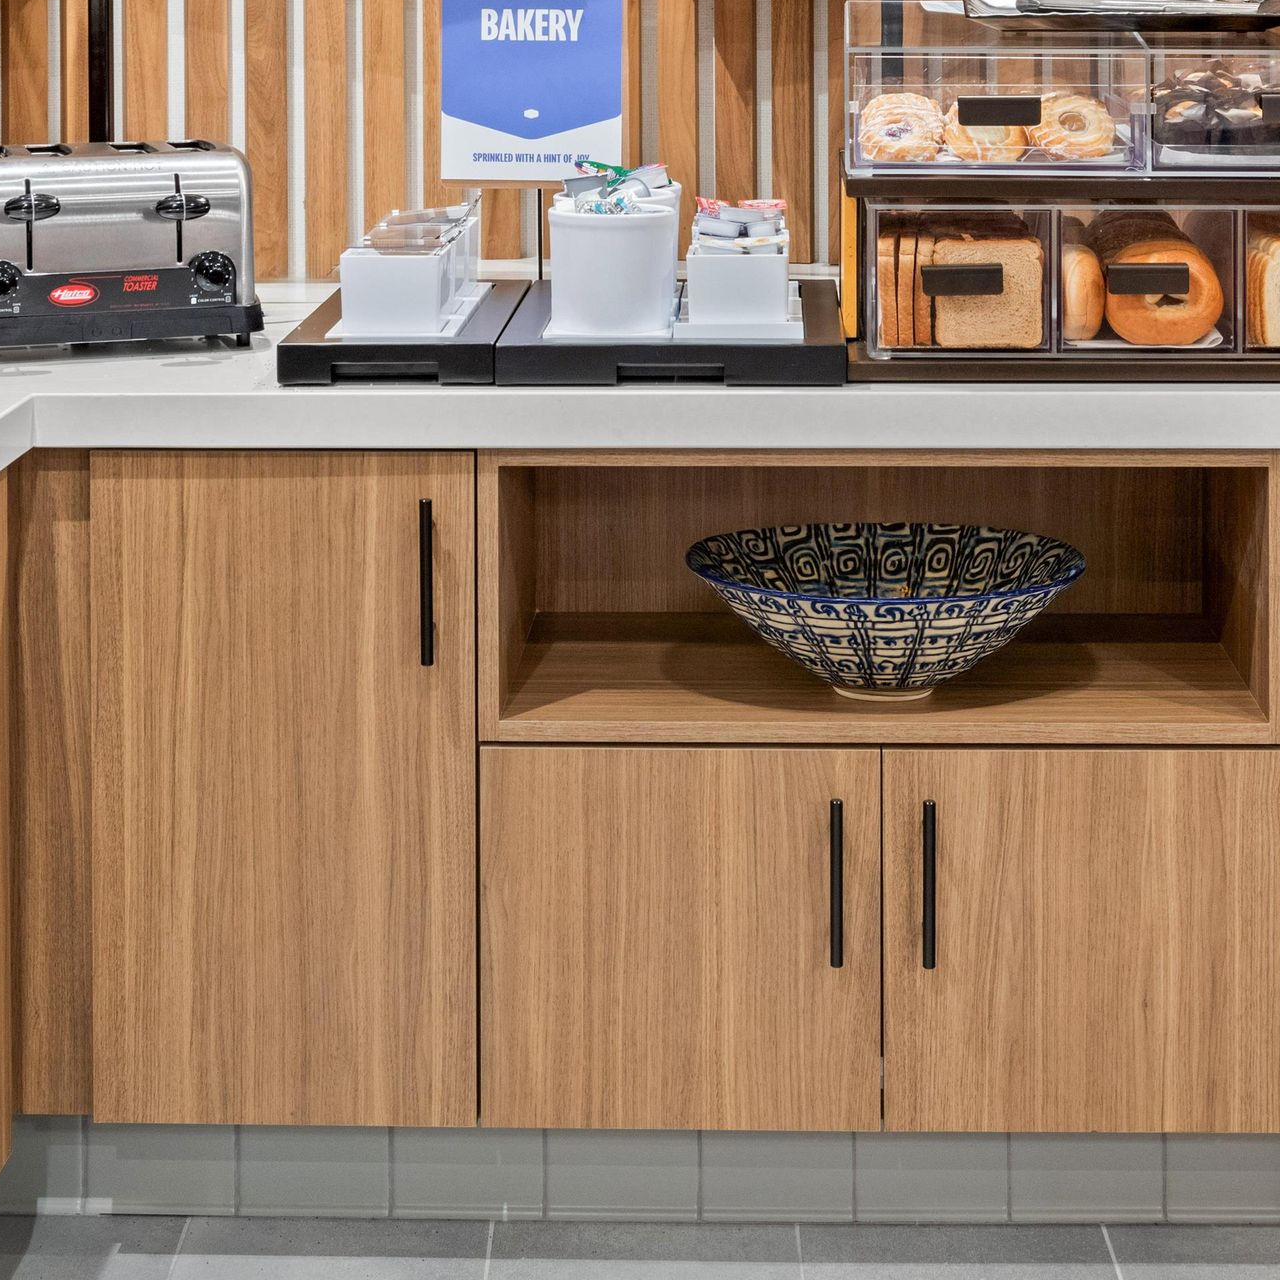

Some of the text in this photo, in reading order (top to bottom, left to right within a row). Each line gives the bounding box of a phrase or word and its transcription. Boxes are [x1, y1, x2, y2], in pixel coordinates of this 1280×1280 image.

[481, 8, 584, 41] BAKERY
[473, 153, 590, 163] SPRINKLED WITH A HINT OF JOY
[124, 274, 159, 282] COMMERCIAL
[123, 281, 158, 292] TOASTER
[51, 288, 92, 300] Hatco
